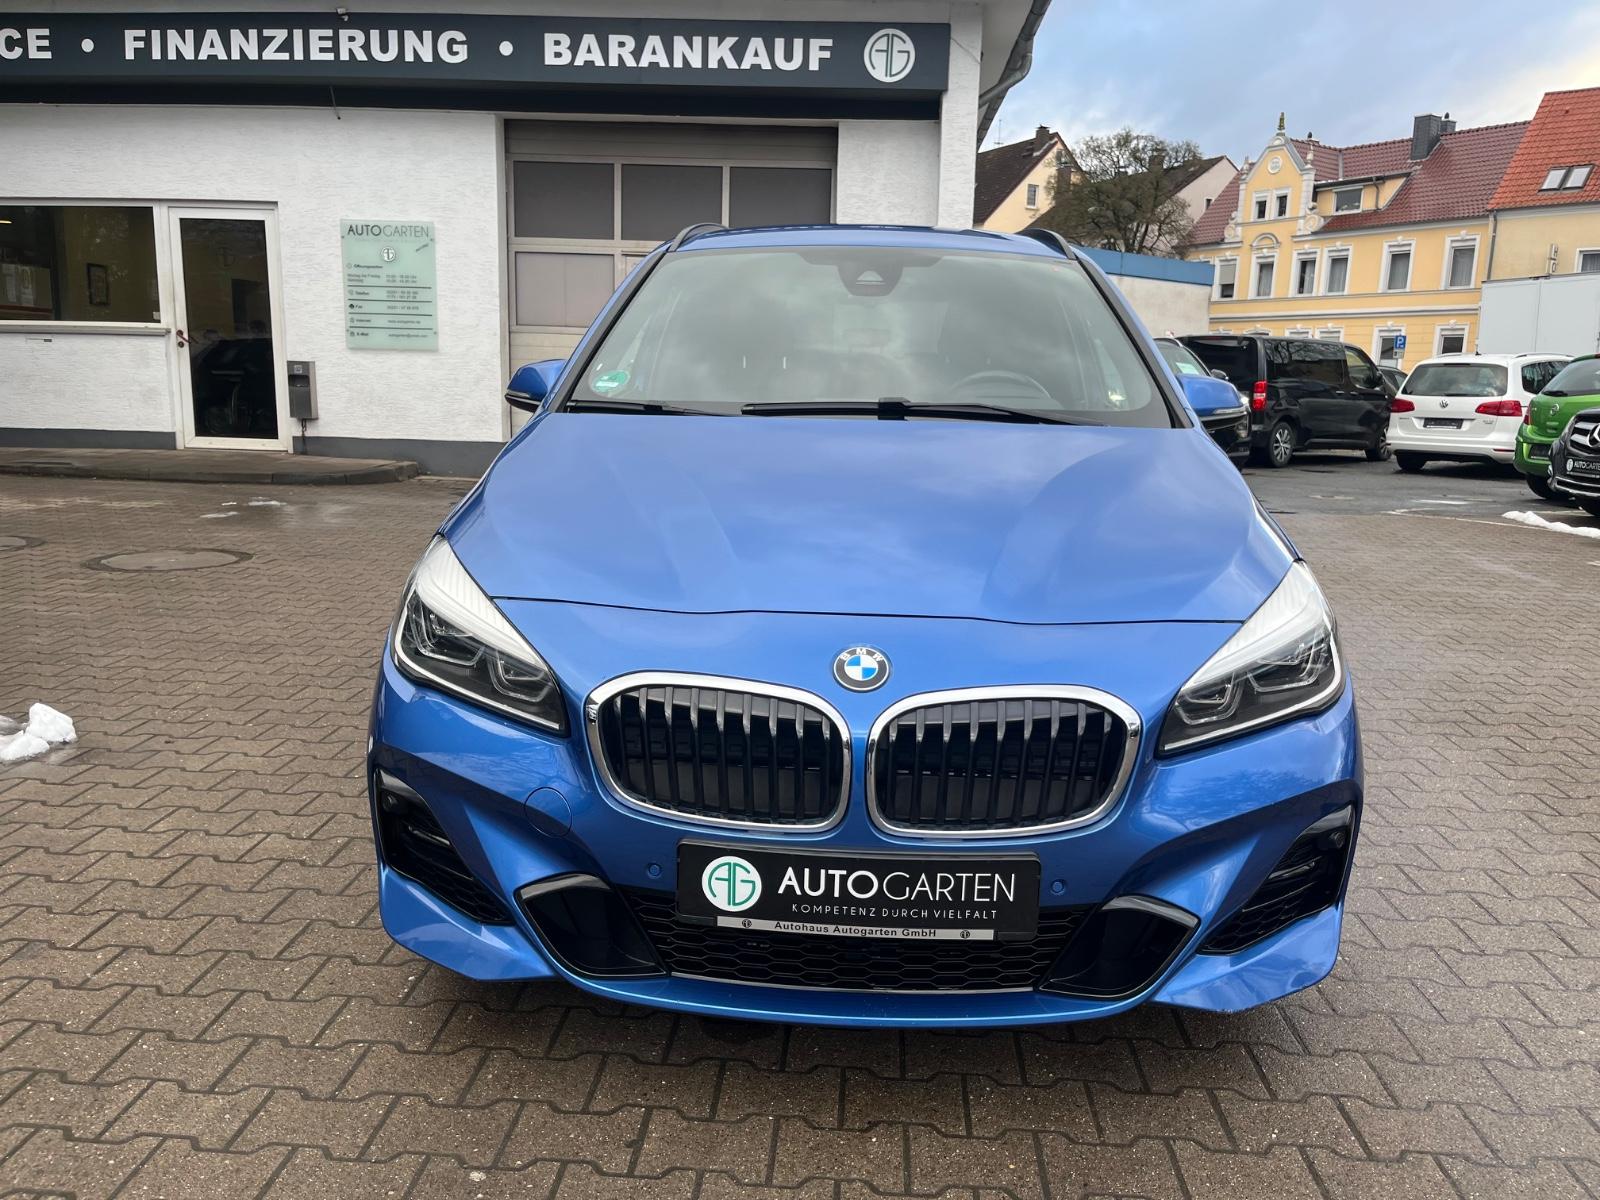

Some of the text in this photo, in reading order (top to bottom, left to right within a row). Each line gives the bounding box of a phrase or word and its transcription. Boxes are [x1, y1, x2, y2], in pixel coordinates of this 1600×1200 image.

[0, 28, 52, 60] CE
[124, 28, 468, 64] FINANZIERUNG
[543, 32, 833, 71] BARANKAUF
[347, 224, 429, 238] AUTOGARTEN
[1396, 336, 1405, 348] P
[839, 647, 885, 662] BMW
[778, 866, 1015, 902] AUTOGARTEN
[791, 903, 998, 920] KOMPETENZ DURCH VIELFALT
[774, 921, 937, 938] Autohaus Autogarten GmbH
